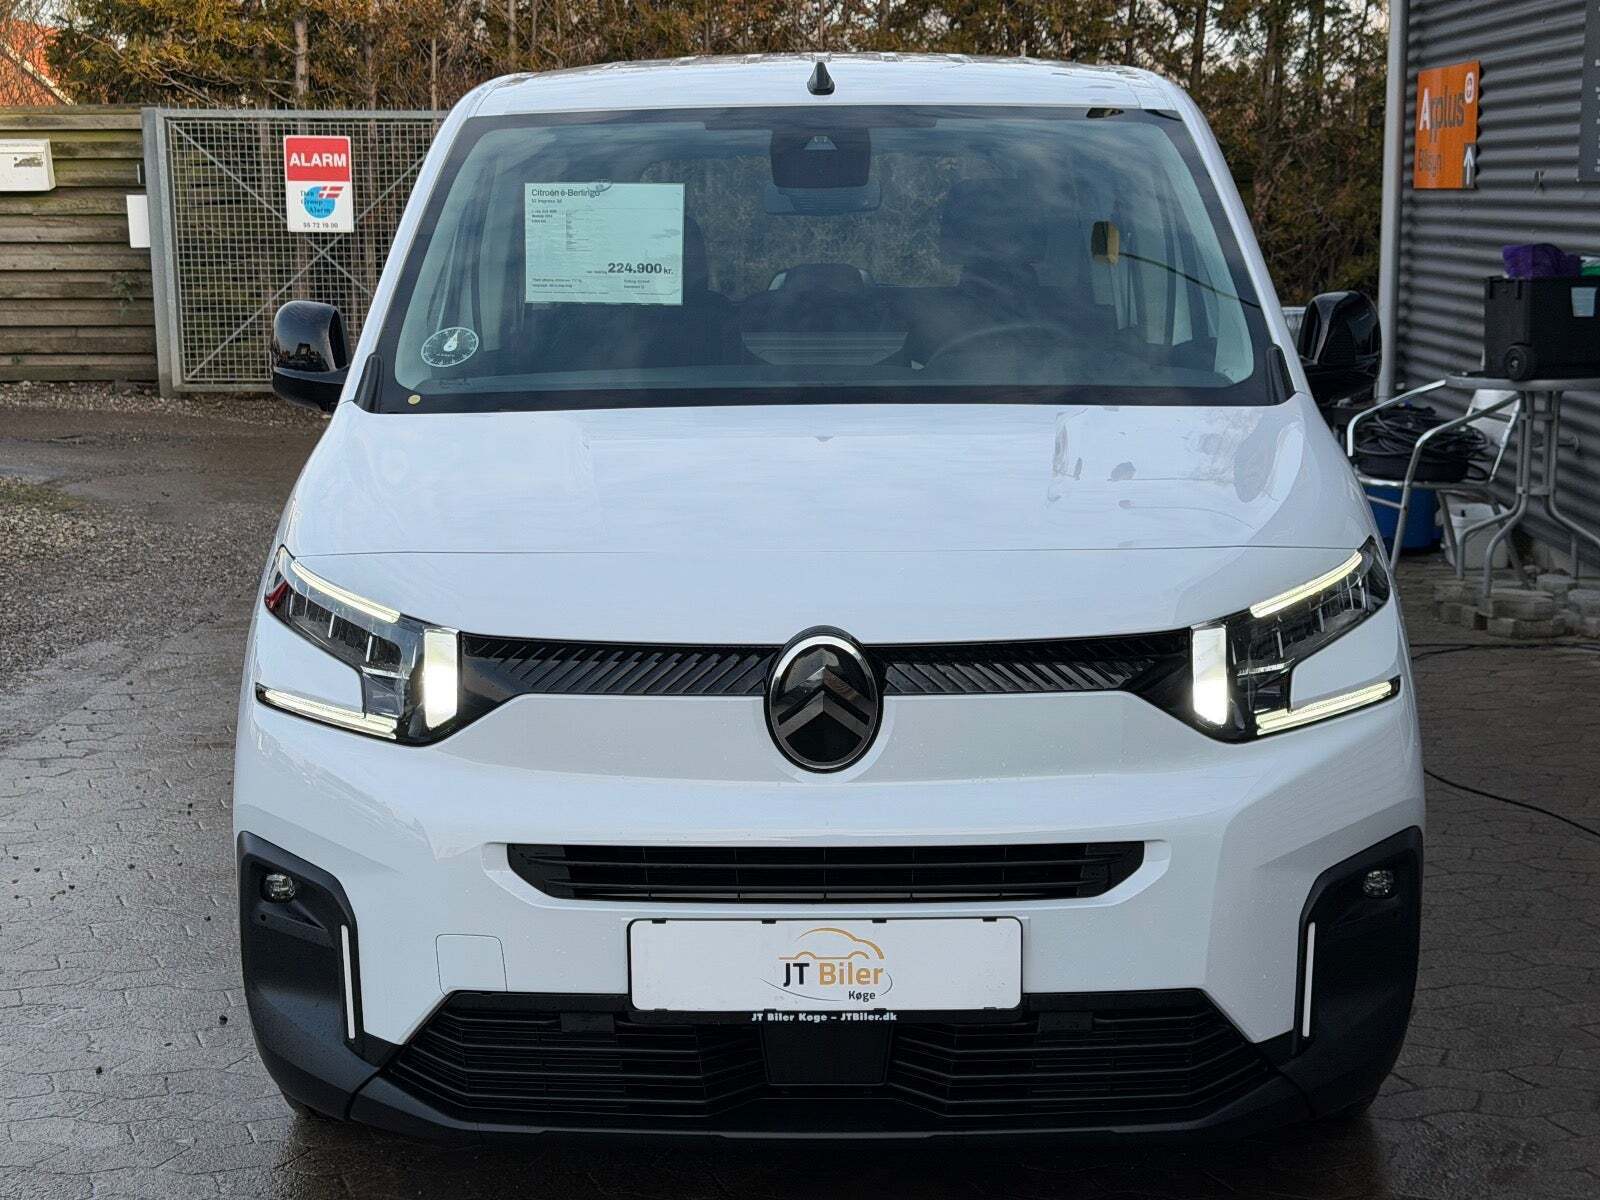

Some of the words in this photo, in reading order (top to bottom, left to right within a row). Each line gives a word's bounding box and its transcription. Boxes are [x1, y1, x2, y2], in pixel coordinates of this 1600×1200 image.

[289, 152, 347, 168] ALARM
[607, 262, 662, 274] 224.900
[783, 962, 810, 987] JT
[819, 961, 884, 986] Biler
[848, 990, 876, 1002] Køge
[751, 1012, 763, 1022] JT
[767, 1012, 795, 1022] Biler
[840, 1011, 897, 1022] JTBiler.dk
